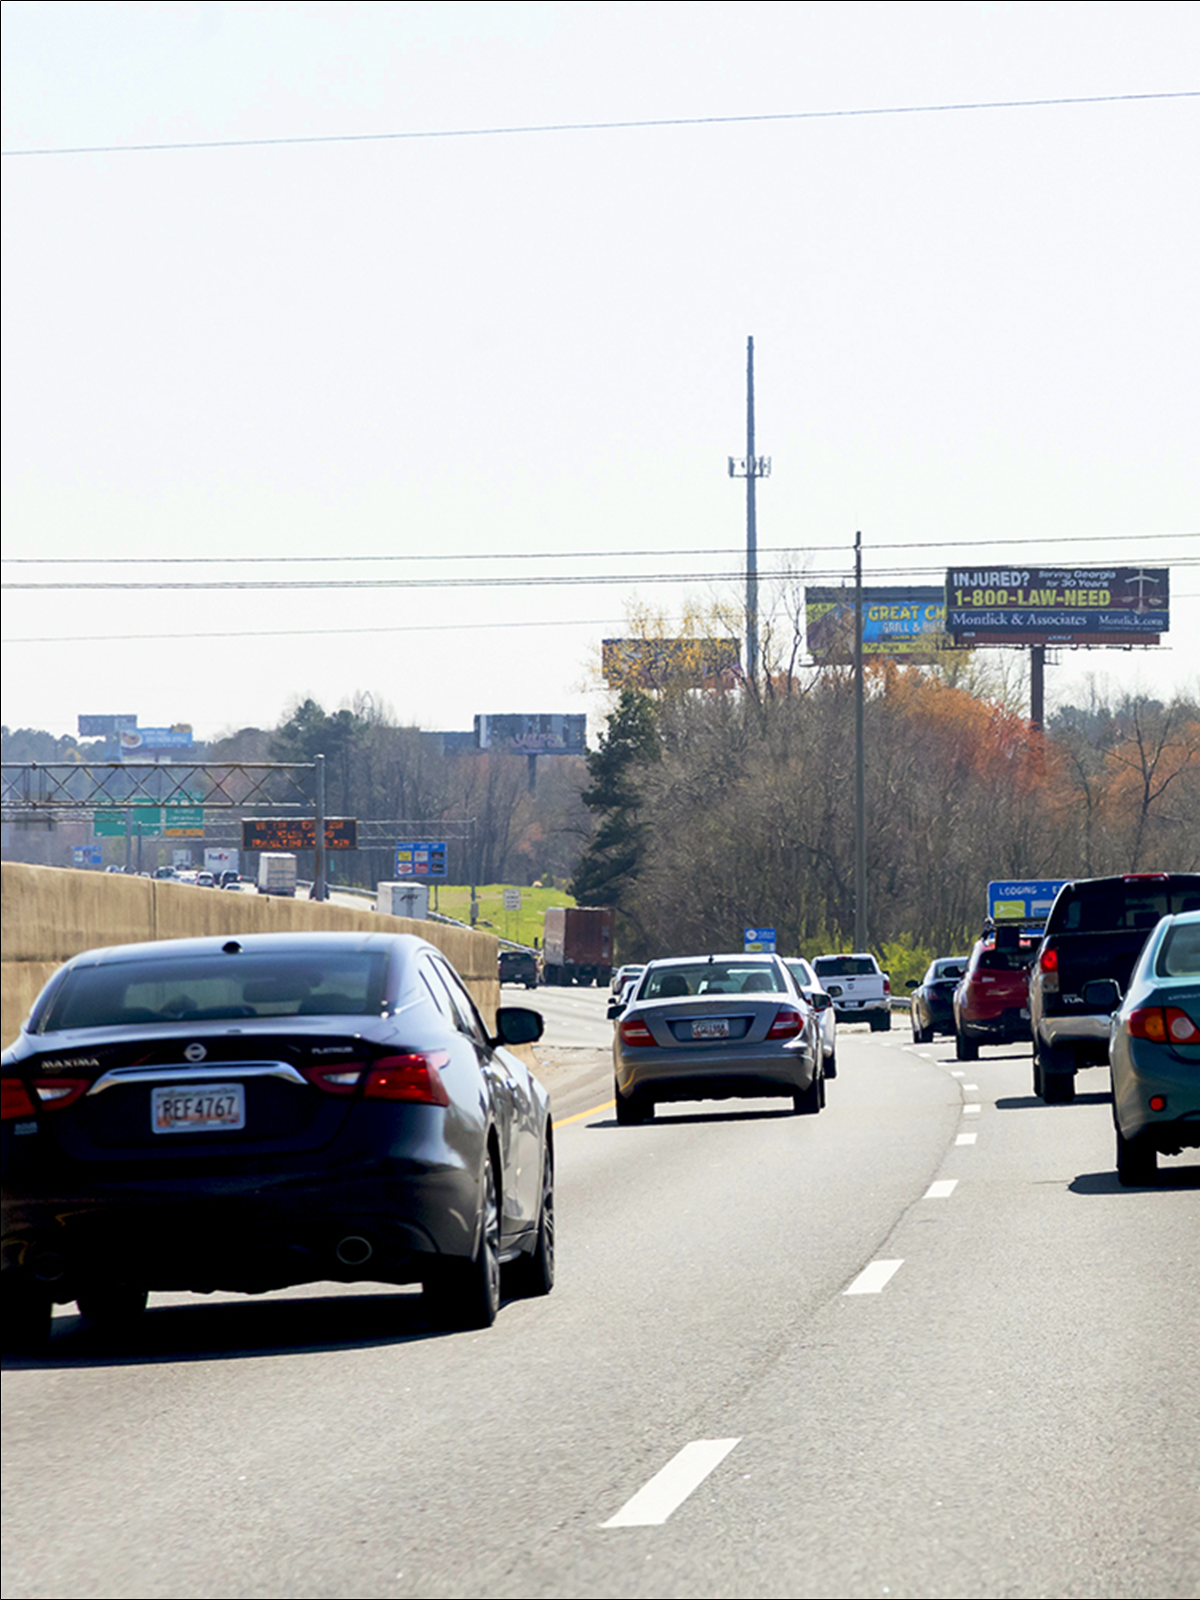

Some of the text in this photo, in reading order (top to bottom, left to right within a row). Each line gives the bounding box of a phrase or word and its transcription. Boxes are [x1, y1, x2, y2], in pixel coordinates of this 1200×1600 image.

[953, 571, 1030, 587] INJURED?
[1039, 570, 1116, 580] Serving Georgia
[1046, 579, 1109, 588] for 30 Years
[954, 589, 1111, 606] 1-800-LAW-NEED
[868, 604, 920, 621] GREAT
[952, 612, 1087, 626] Montlick & Associates
[1099, 615, 1164, 626] Montlick.com
[912, 621, 920, 633] &
[999, 886, 1037, 896] LODGING
[41, 1059, 99, 1069] MAXIMA
[163, 1097, 235, 1121] REF4767
